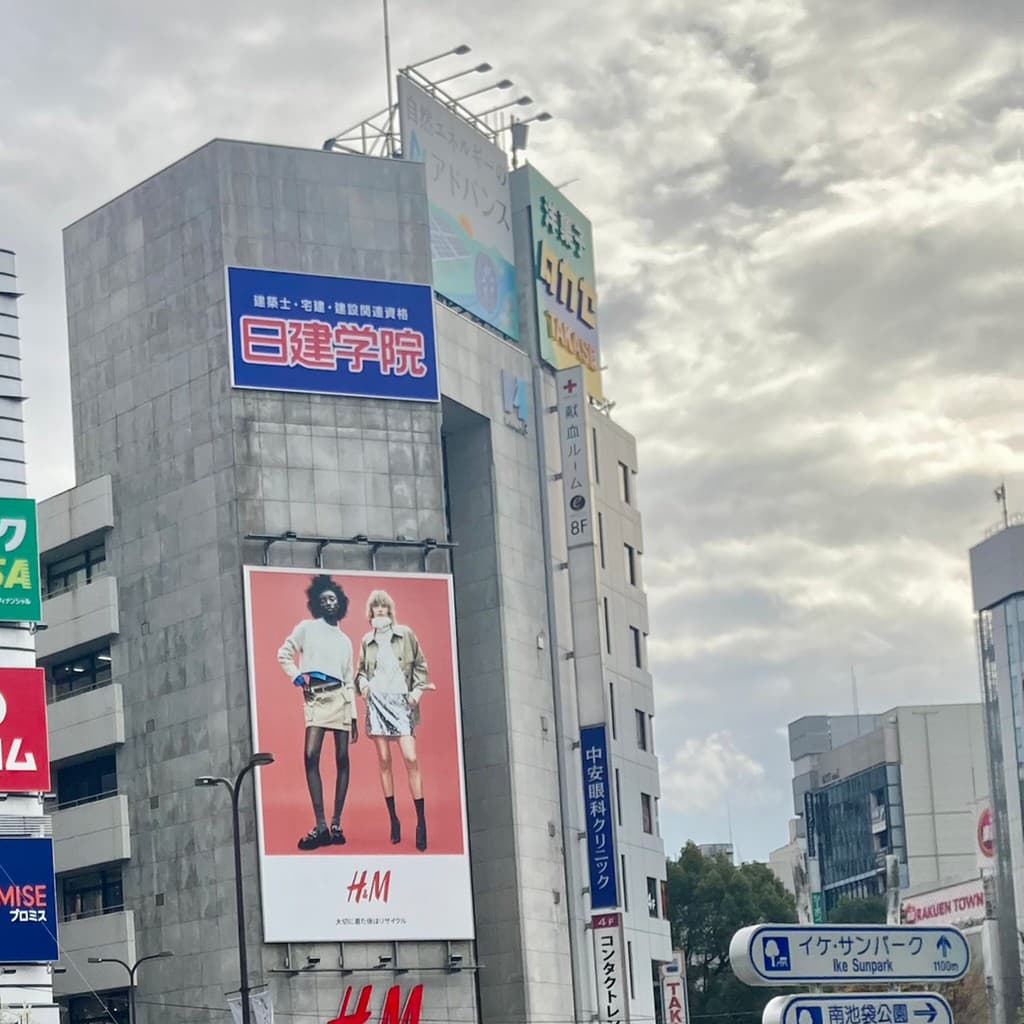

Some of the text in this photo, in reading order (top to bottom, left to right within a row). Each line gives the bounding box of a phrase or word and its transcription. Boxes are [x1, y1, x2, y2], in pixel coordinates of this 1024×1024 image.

[240, 315, 427, 378] 日建学院
[564, 404, 583, 490] 献血ルーム
[570, 519, 588, 536] 8F
[585, 746, 610, 891] 中安眼科クリニック
[347, 870, 391, 904] H&M
[9, 909, 47, 922] プロミス
[915, 892, 985, 922] RAKUEN TOWN
[597, 917, 615, 927] 4F
[833, 958, 894, 975] Ike Sunpark
[932, 960, 959, 972] 1100m
[827, 1004, 908, 1024] 南池袋公園
